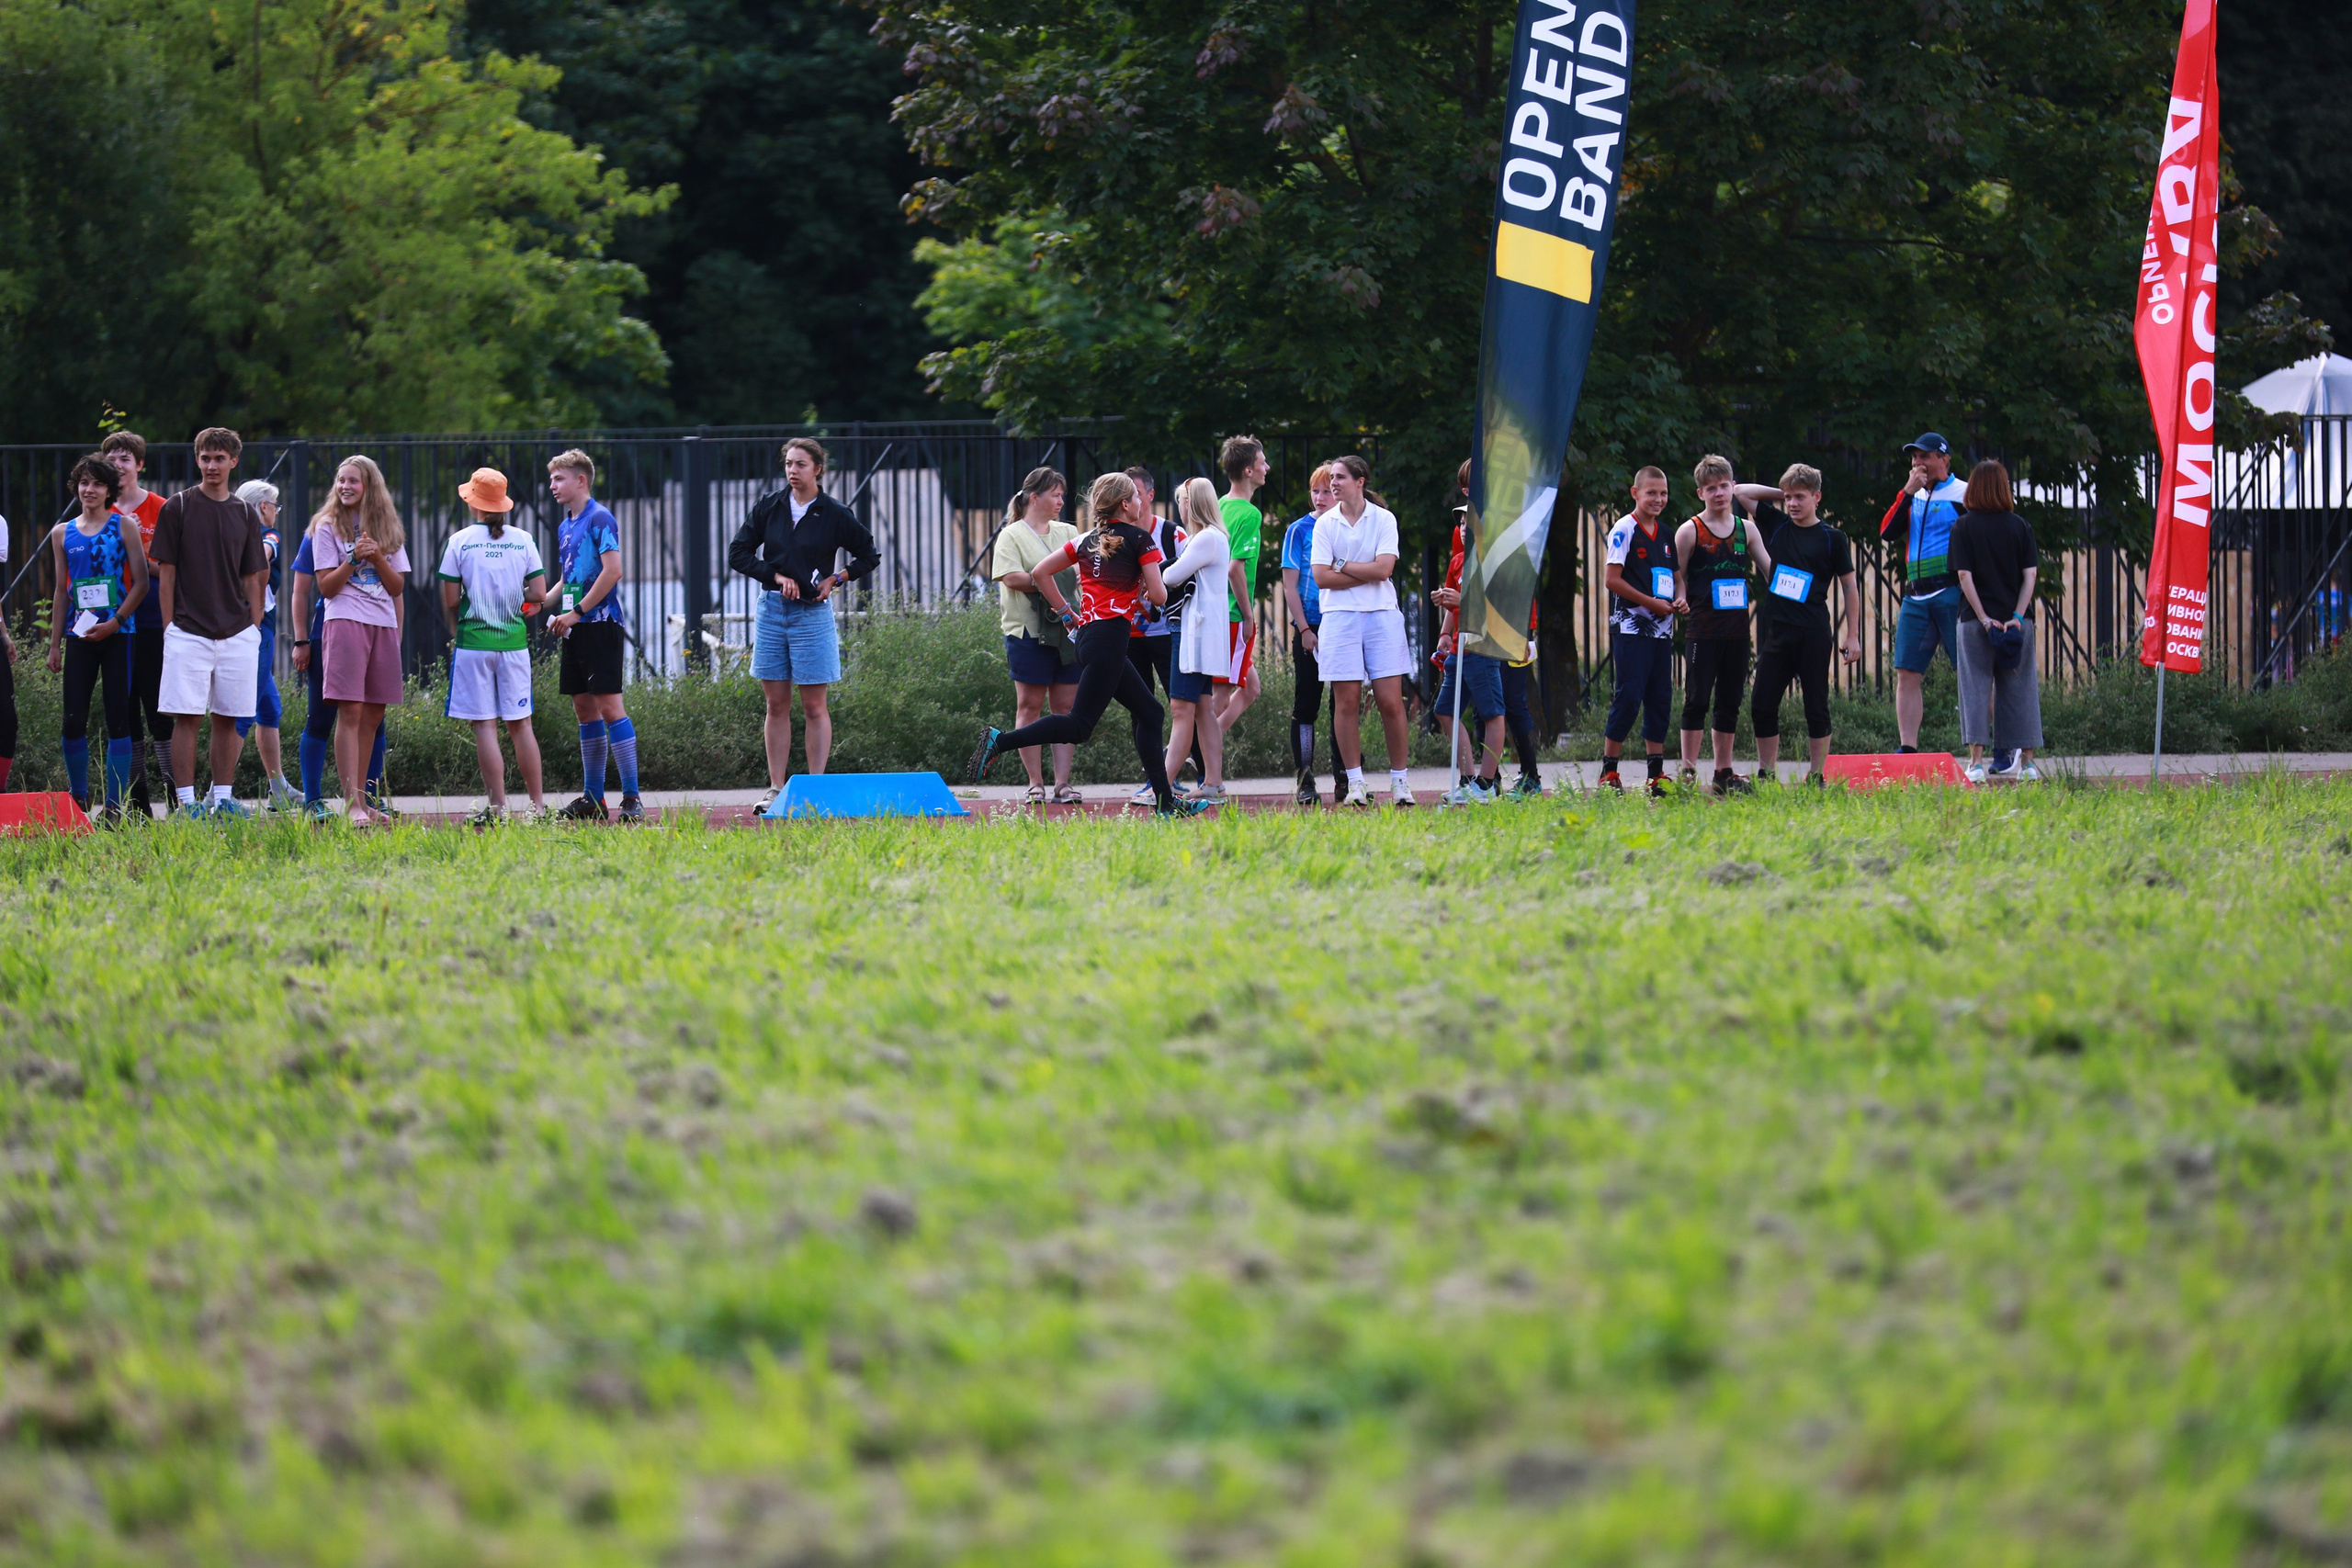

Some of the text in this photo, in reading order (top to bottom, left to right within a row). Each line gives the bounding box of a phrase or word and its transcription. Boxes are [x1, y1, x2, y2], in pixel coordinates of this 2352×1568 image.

[1502, 0, 1576, 210] OPEN
[1559, 11, 1627, 231] BAND
[462, 542, 525, 551] Санкт-Петербург
[2169, 585, 2207, 606] ЕРАЦ
[2166, 641, 2200, 658] ОСКВ
